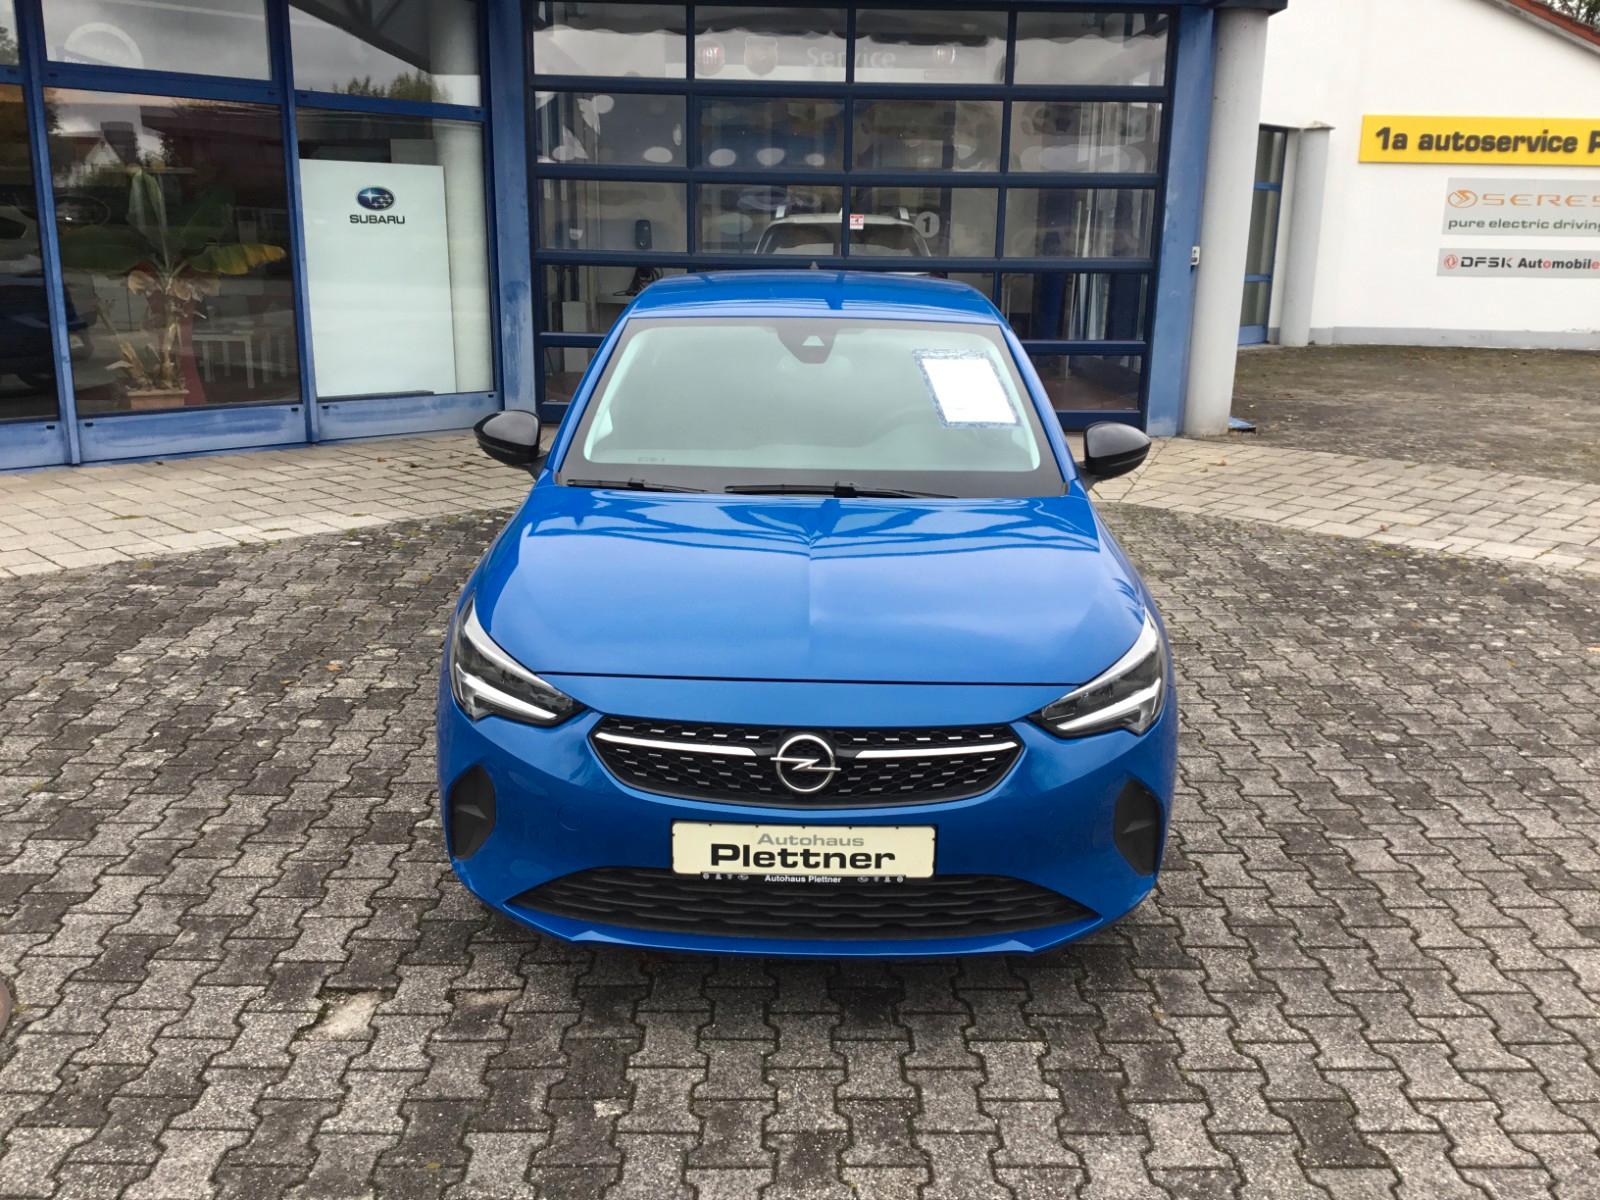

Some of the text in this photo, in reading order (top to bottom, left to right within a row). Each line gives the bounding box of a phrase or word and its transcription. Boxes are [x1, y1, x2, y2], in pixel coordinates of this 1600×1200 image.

[1375, 127, 1408, 151] 1a
[1418, 129, 1578, 153] autoservice
[349, 214, 406, 225] SUBARU
[1448, 219, 1485, 230] pure
[1489, 217, 1550, 230] electric
[1460, 256, 1513, 269] DFSK
[756, 833, 865, 847] Autohaus
[710, 843, 896, 869] Plettner
[764, 874, 842, 884] Autohaus Plettner
